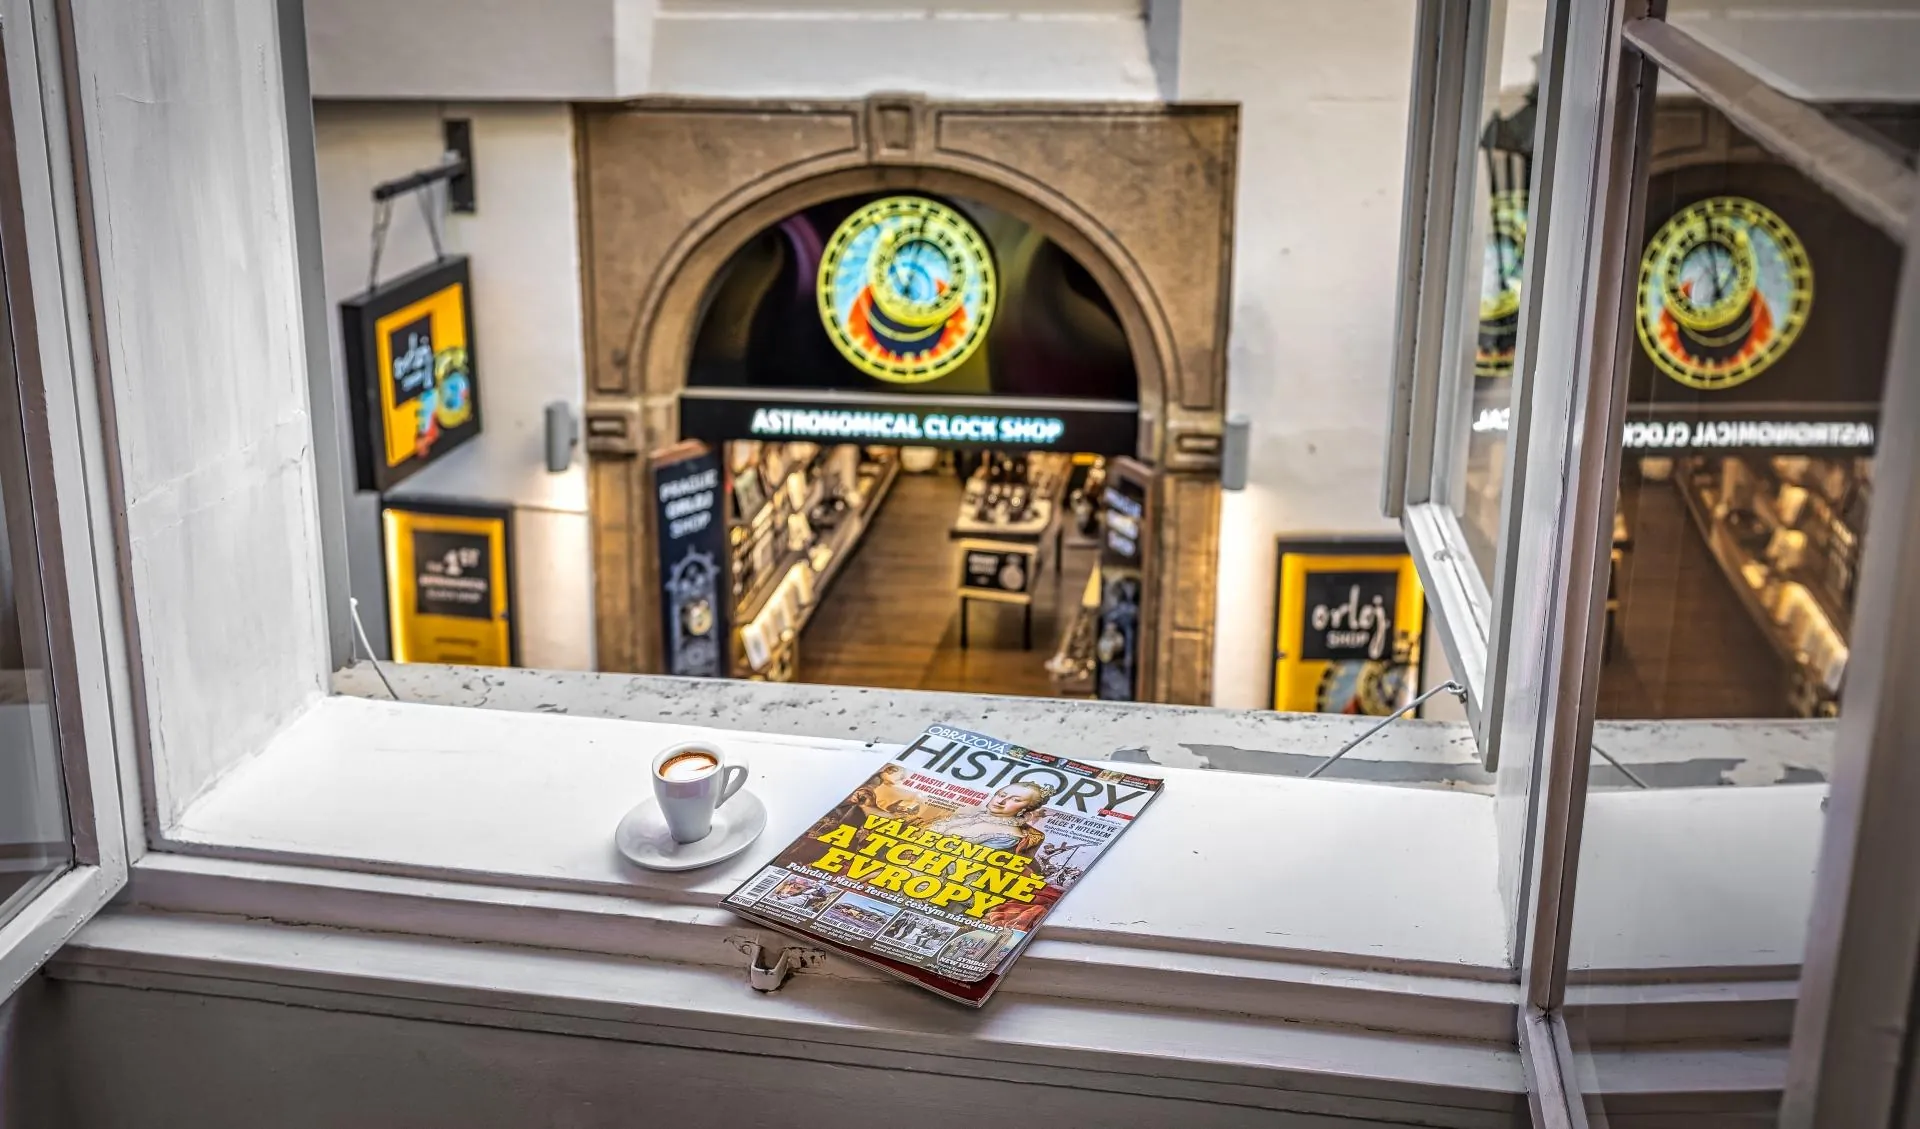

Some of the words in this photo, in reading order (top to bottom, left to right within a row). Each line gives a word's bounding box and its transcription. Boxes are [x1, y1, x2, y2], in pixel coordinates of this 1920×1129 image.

[752, 408, 921, 438] ASTRONOMICAL
[923, 414, 998, 440] CLOCK
[999, 417, 1063, 443] SHOP
[669, 510, 712, 539] SHOP
[1326, 630, 1370, 648] SHOP
[928, 726, 1008, 754] OBRAZOVÁ
[896, 734, 1147, 817] HISTORY
[902, 779, 913, 787] NA
[910, 773, 946, 789] DYNASTIE
[862, 814, 1033, 873] VÁLEČNICE
[1074, 825, 1112, 840] HITLEREM
[816, 823, 857, 848] A
[858, 833, 1047, 904] TCHYNĚ
[811, 846, 1006, 918] EVROPY
[786, 862, 833, 881] Pohrdala
[832, 875, 866, 891] Marie
[864, 885, 905, 904] Terezie
[905, 899, 946, 918] českým
[945, 911, 1004, 934] národem?
[939, 956, 959, 967] NEW
[957, 961, 986, 973] YORKU
[957, 956, 989, 969] SYMBOL
